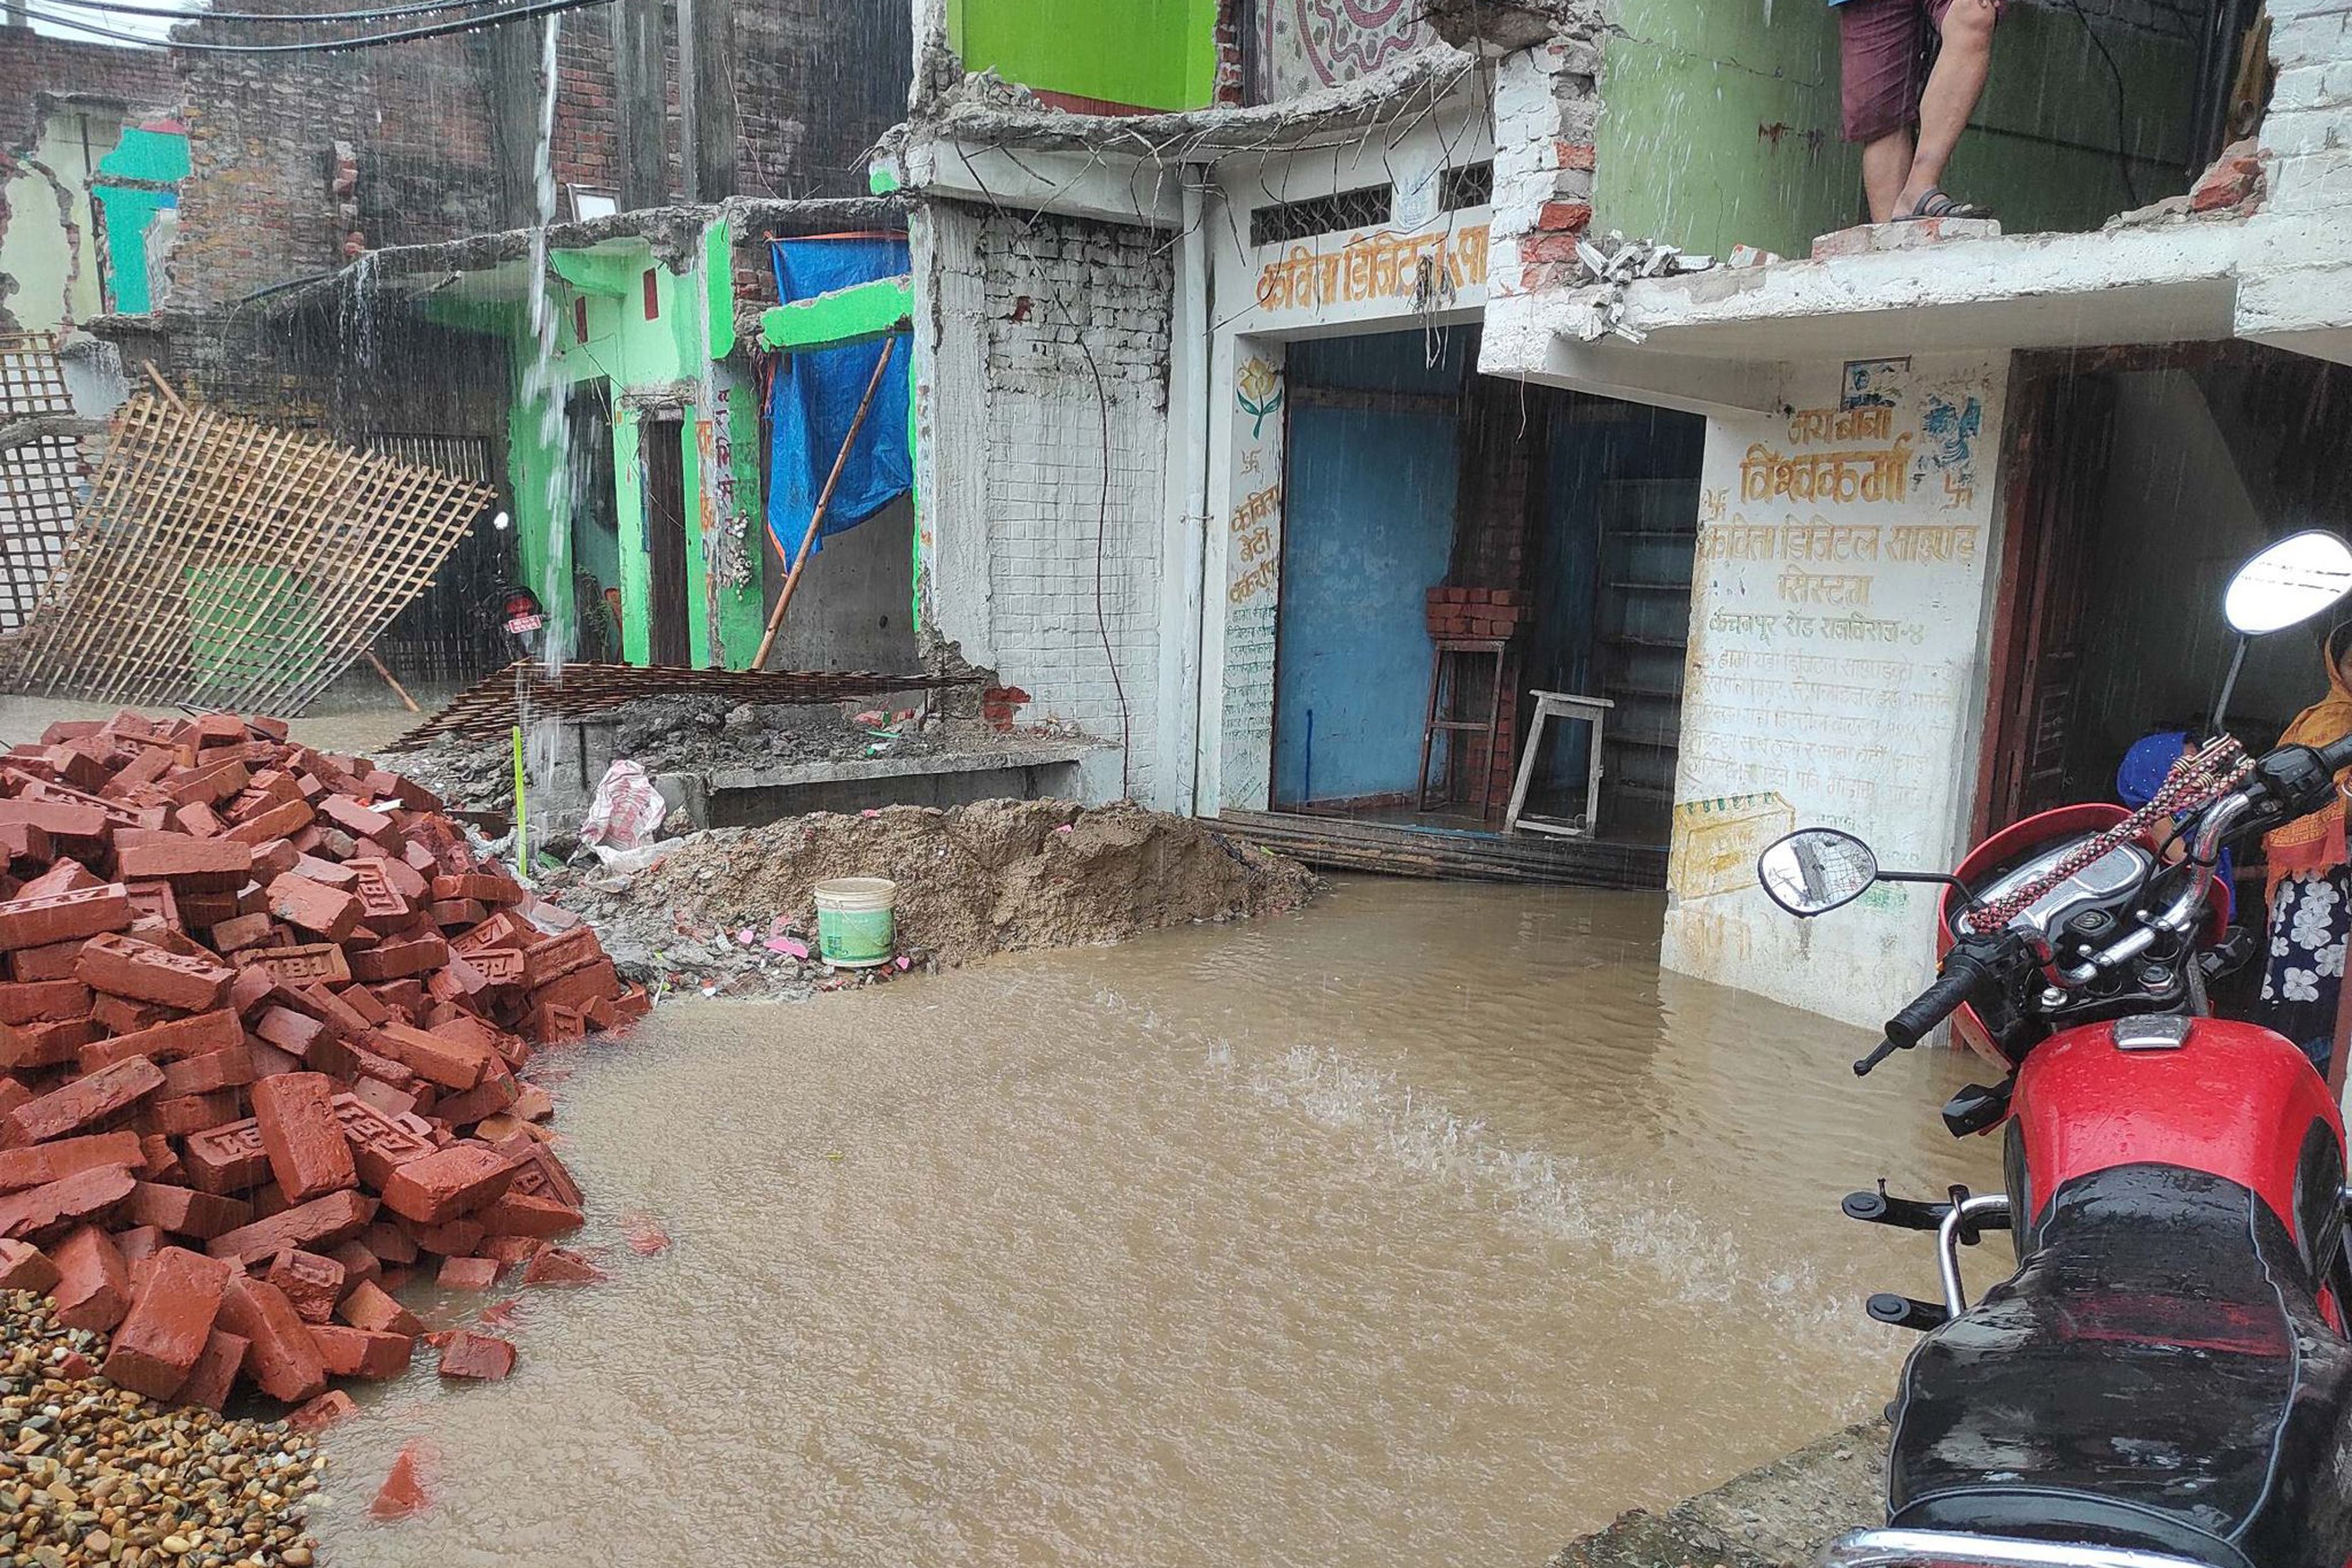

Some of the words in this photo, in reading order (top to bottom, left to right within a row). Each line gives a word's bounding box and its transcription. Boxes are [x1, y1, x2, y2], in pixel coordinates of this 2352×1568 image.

[1257, 246, 1342, 312] कविता
[1788, 410, 1837, 444] जय
[1740, 431, 1913, 504] विश्वकर्मा
[1699, 512, 1776, 560] कविता
[1780, 512, 1880, 562] डिजिटल
[1777, 563, 1873, 606] सिस्टम
